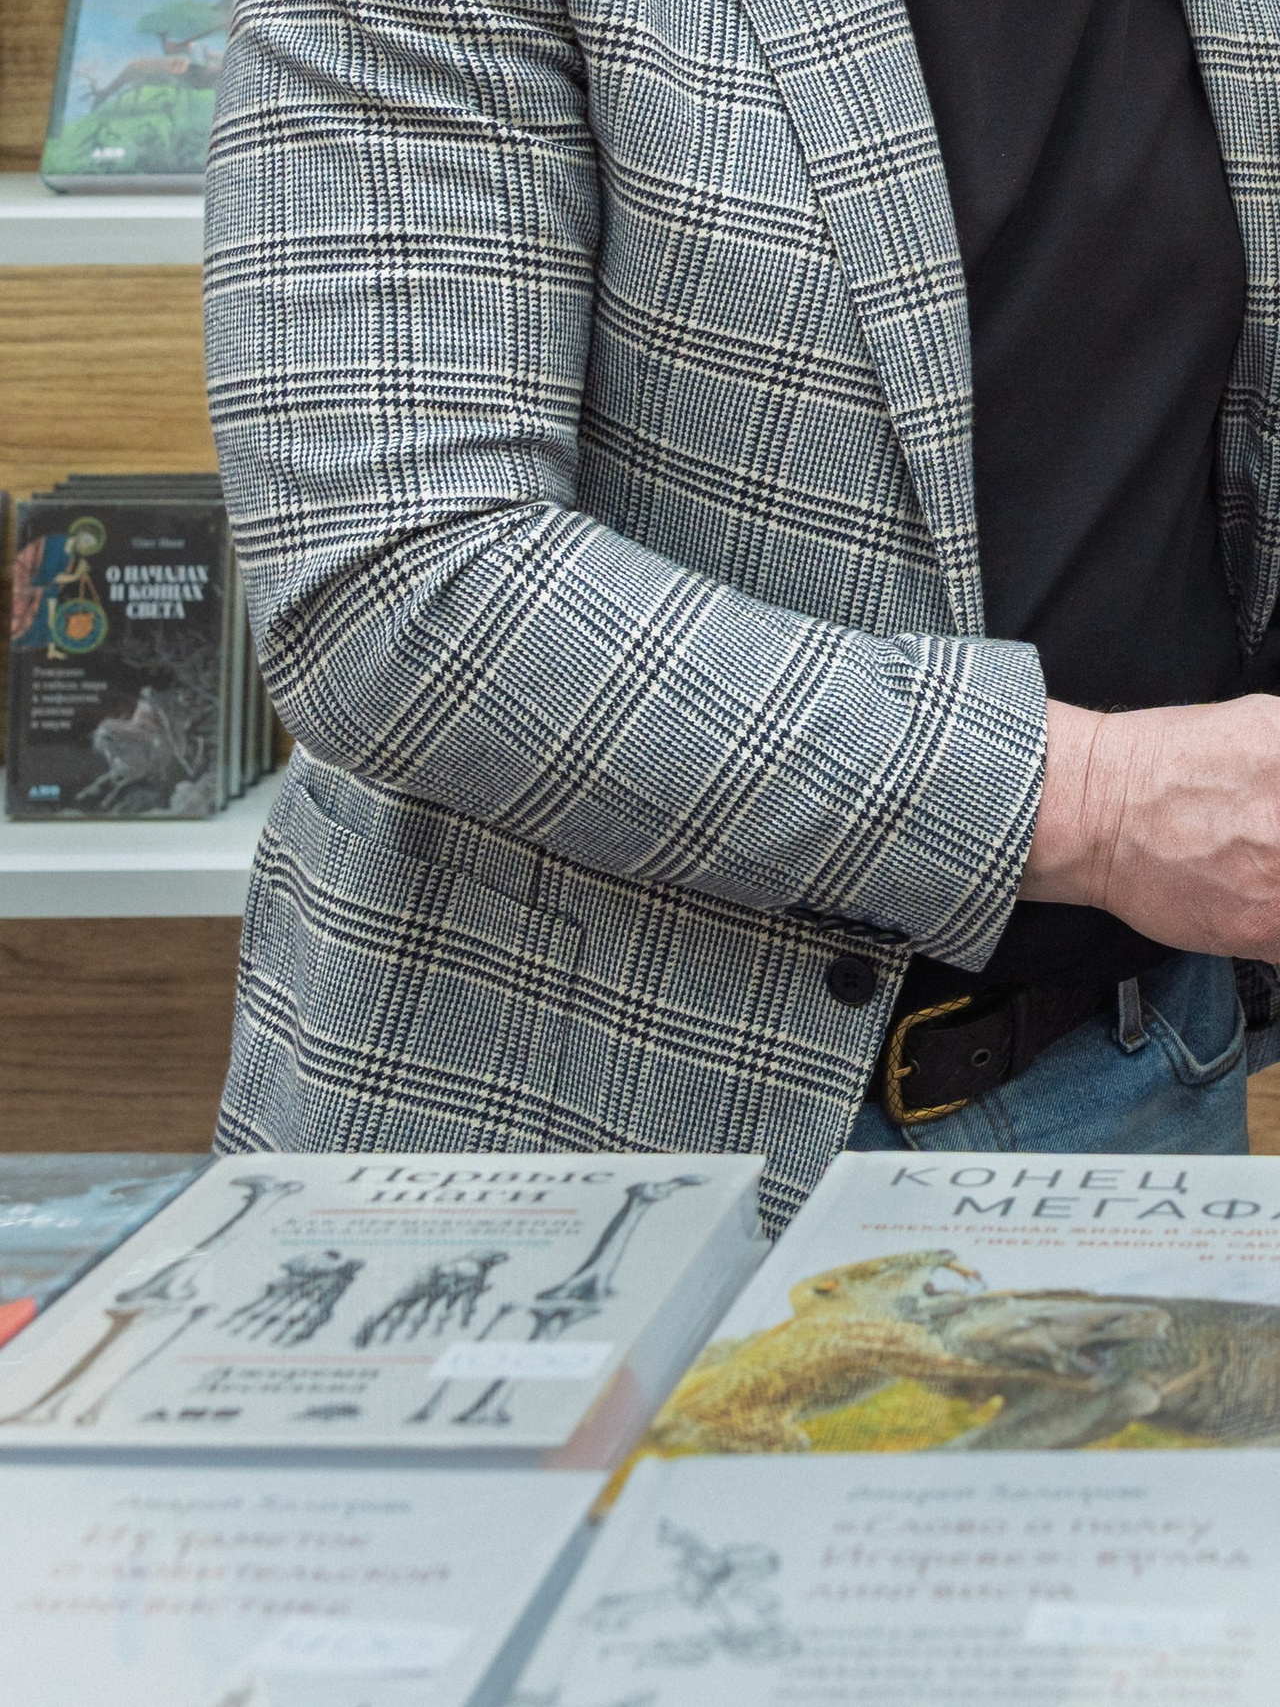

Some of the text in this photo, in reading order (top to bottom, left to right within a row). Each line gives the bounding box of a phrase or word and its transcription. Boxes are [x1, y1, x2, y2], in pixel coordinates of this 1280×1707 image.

[345, 1166, 615, 1187] Первые
[890, 1167, 1189, 1194] КОНЕЦ
[369, 1190, 550, 1204] шаги
